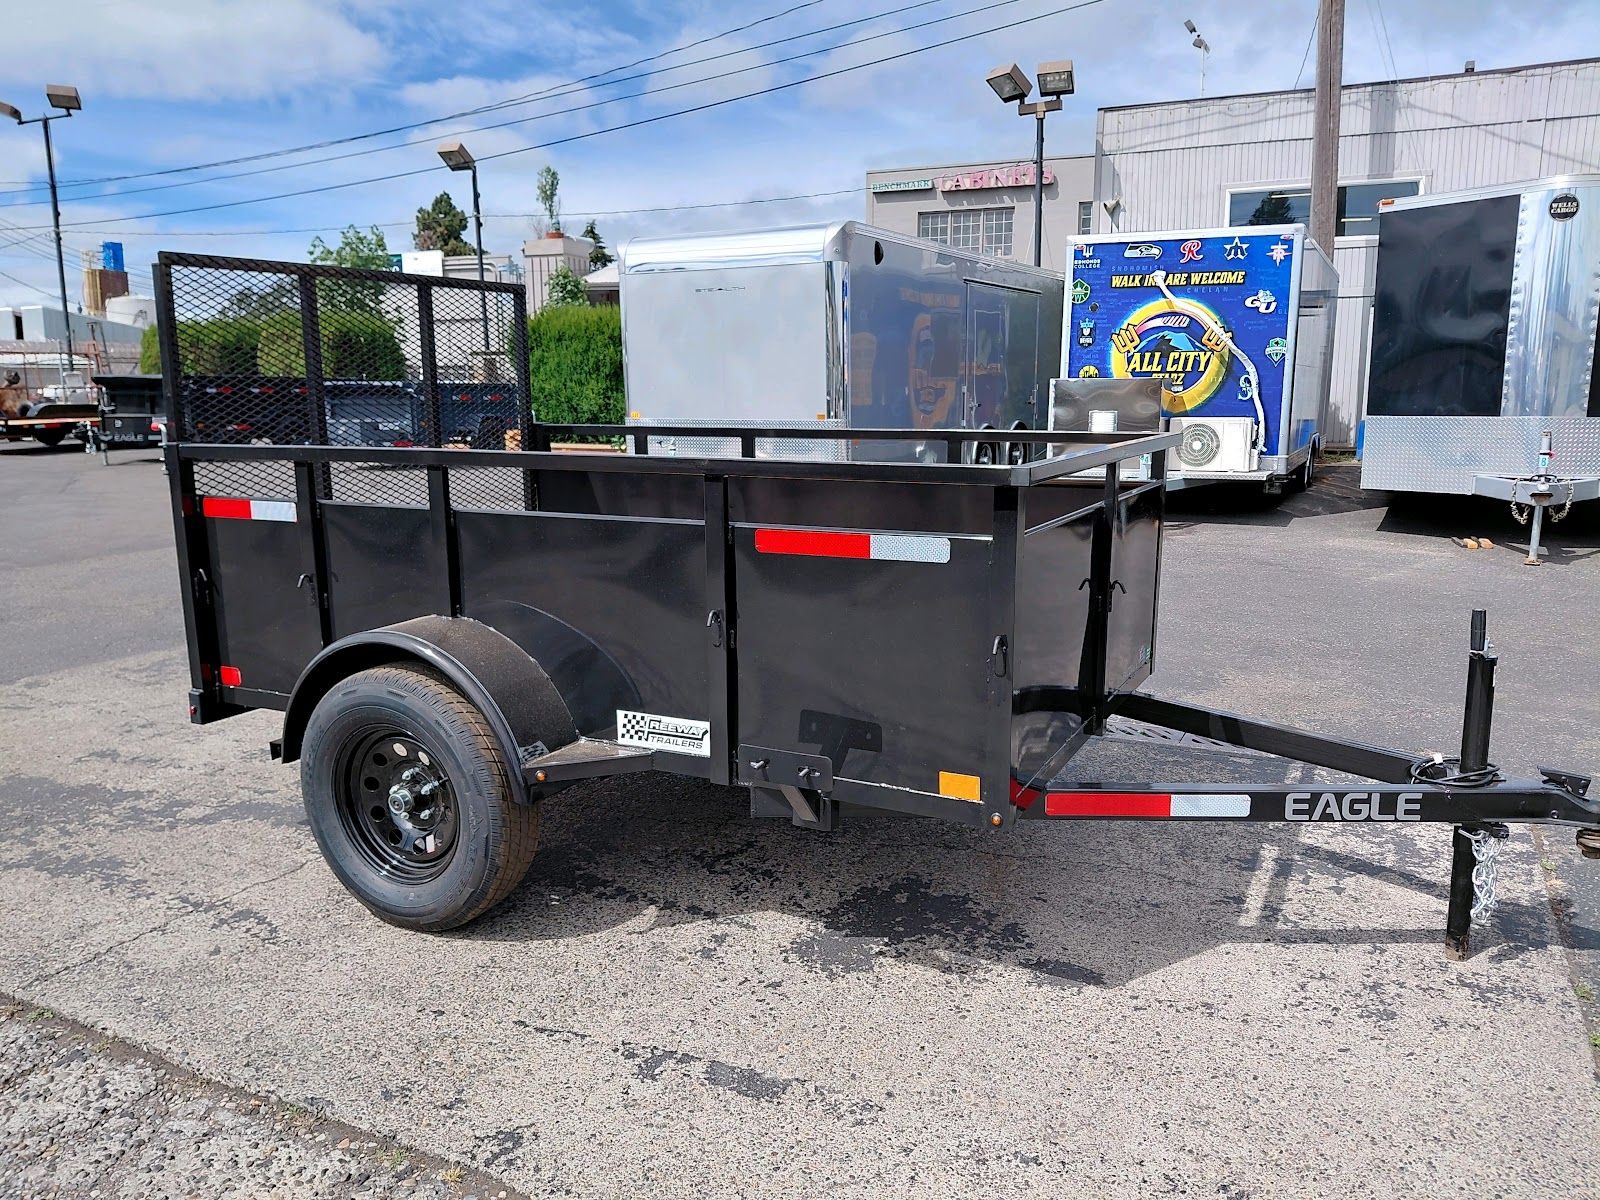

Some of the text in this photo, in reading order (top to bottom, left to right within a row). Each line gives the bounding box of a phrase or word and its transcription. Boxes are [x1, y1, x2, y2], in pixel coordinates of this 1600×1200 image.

[872, 180, 930, 190] BENCHMARK
[937, 164, 1054, 191] CABINETS
[1111, 275, 1142, 288] WALK
[1165, 273, 1188, 286] ARE
[1190, 271, 1246, 285] WELCOME
[1127, 351, 1213, 372] ALL CITY
[114, 433, 143, 441] EAGLE
[650, 735, 703, 749] TRAILERS
[1284, 792, 1423, 821] EAGLE
